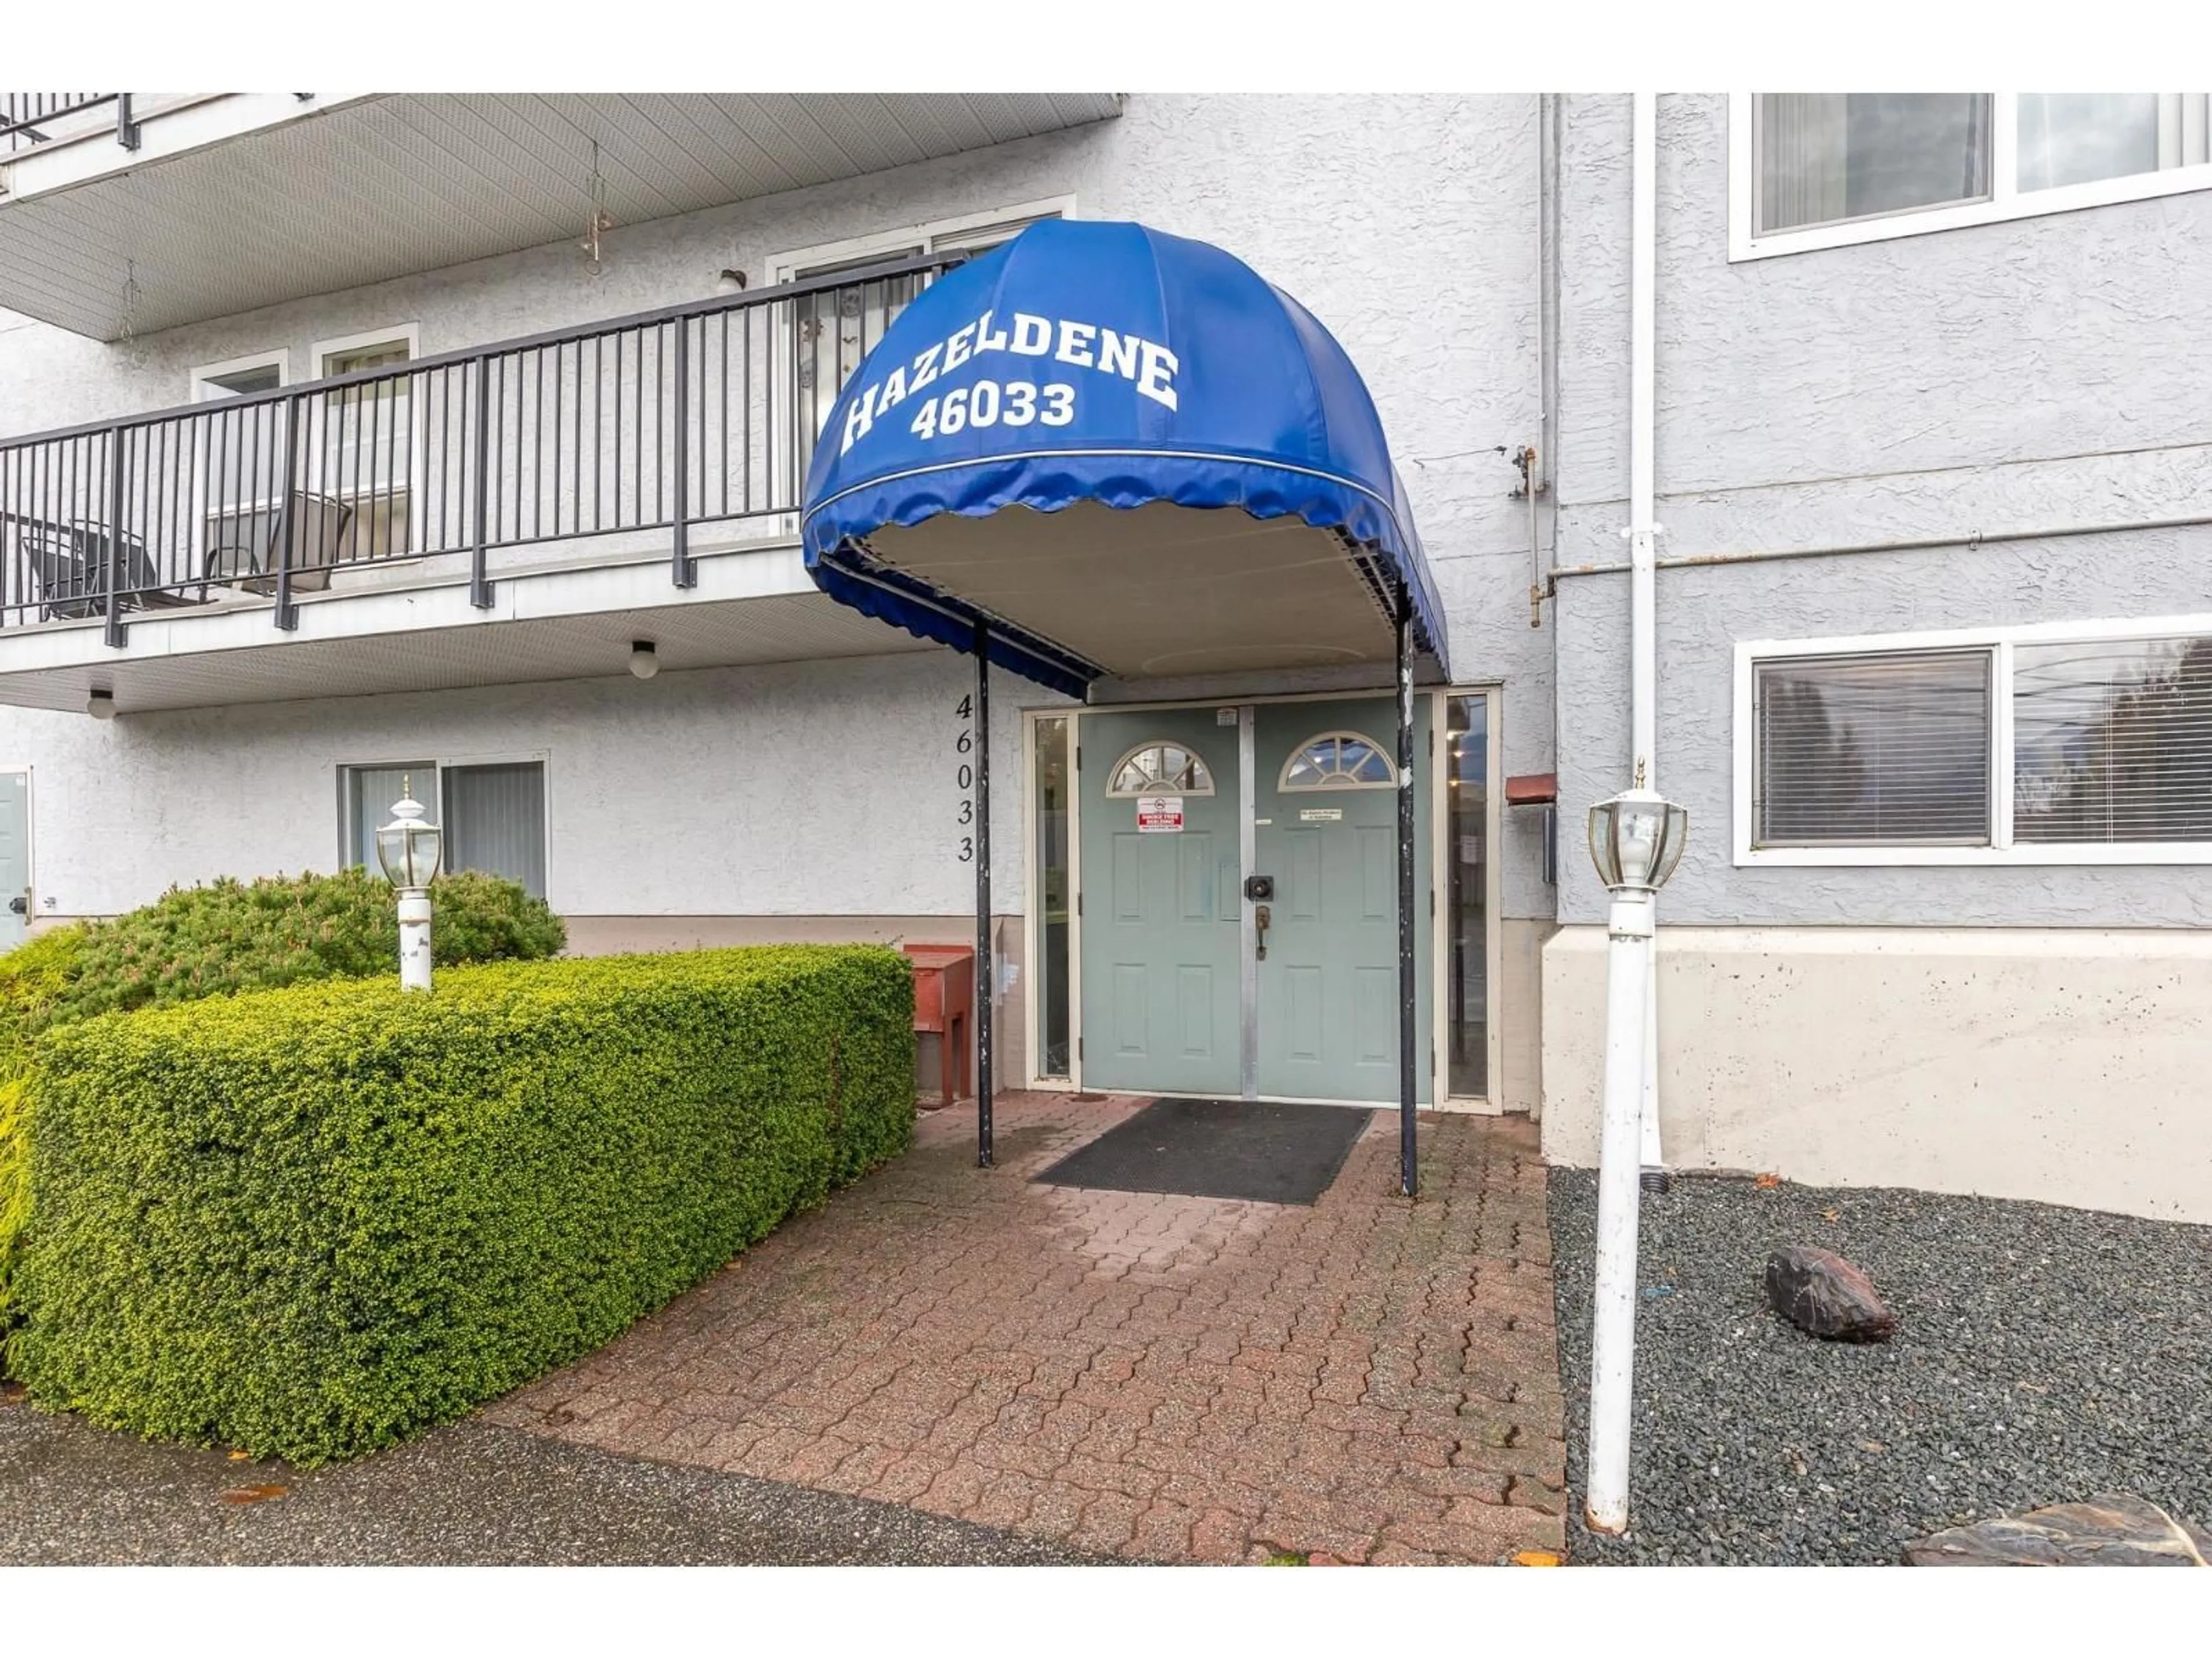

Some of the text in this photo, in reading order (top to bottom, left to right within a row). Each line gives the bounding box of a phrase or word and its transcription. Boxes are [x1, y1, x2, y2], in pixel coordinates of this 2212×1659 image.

[840, 309, 1179, 456] HAZELDENE
[910, 380, 1076, 440] 46033
[955, 694, 973, 862] 46033
